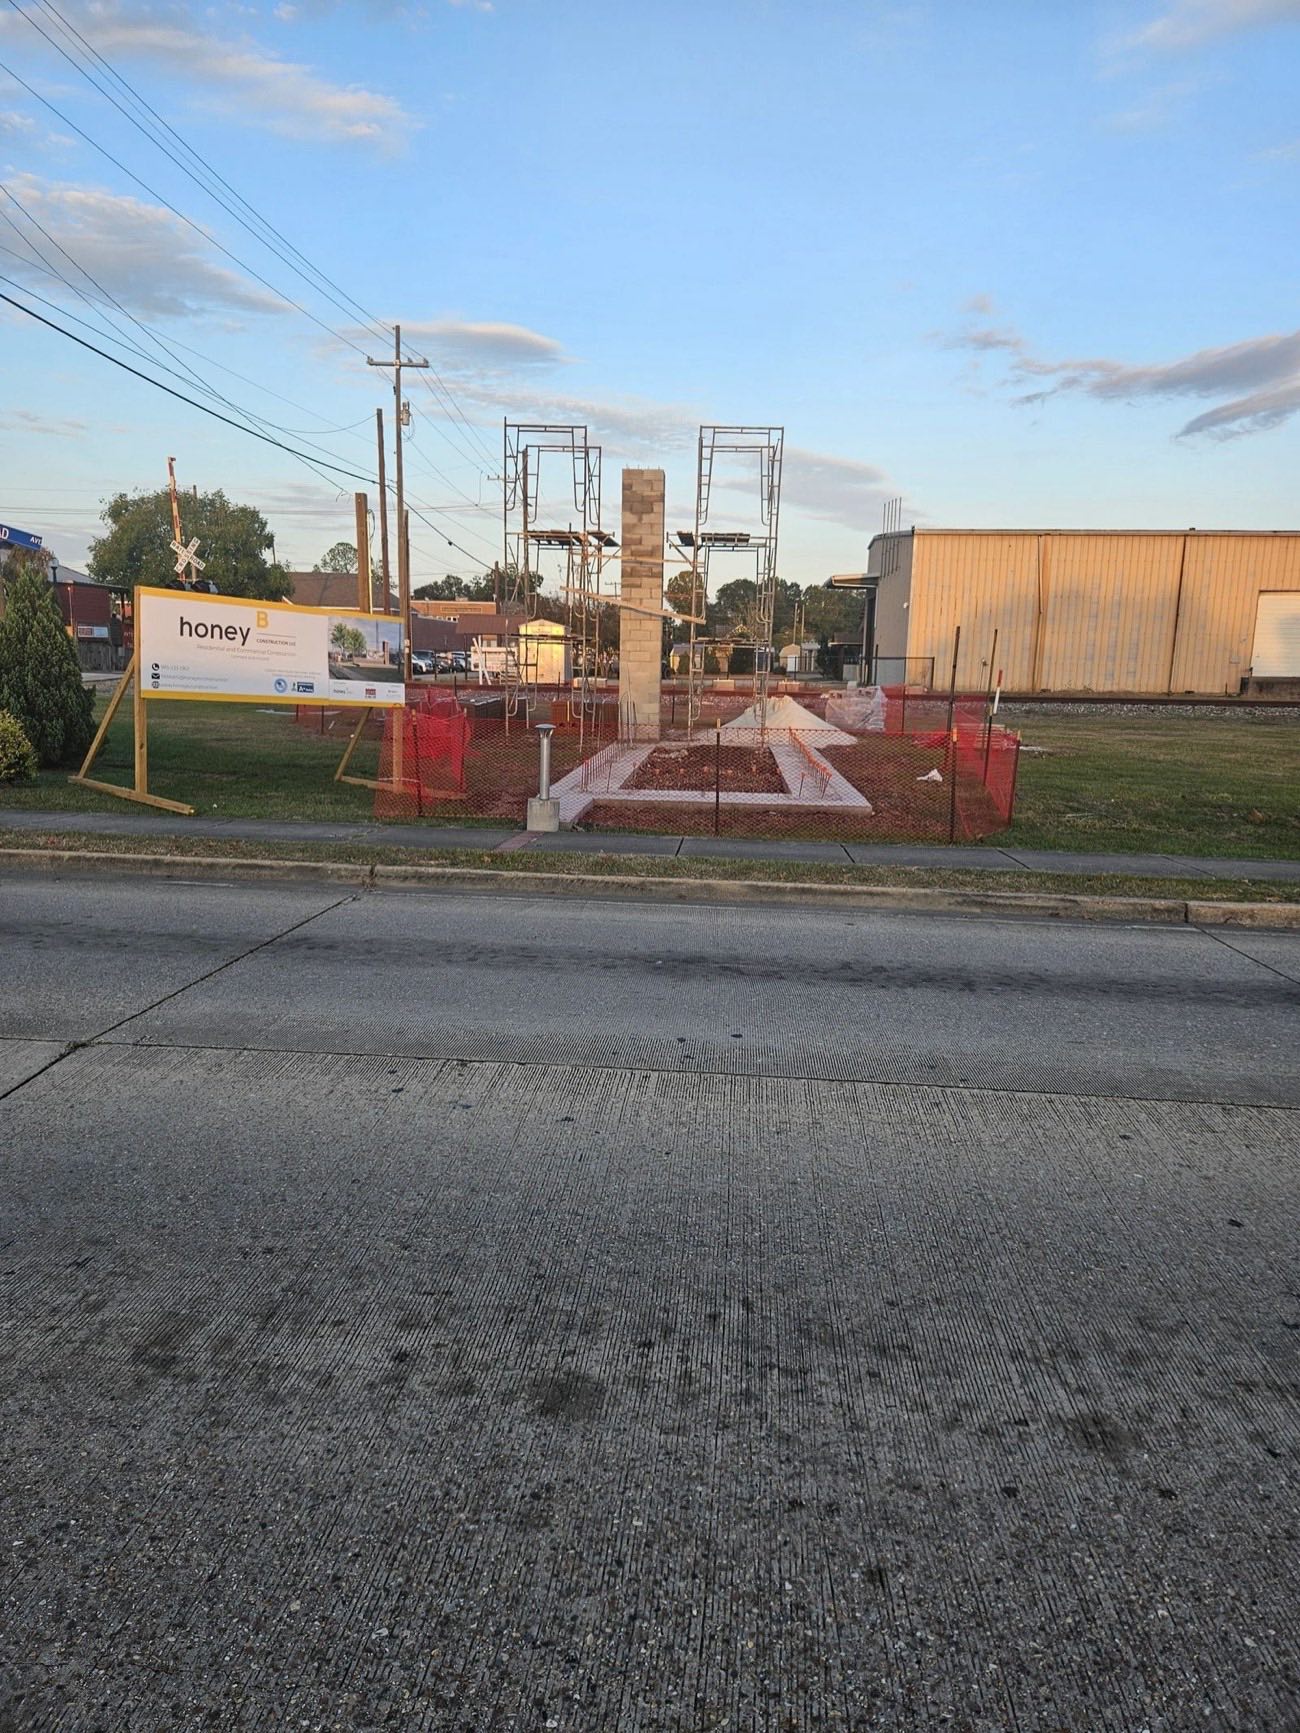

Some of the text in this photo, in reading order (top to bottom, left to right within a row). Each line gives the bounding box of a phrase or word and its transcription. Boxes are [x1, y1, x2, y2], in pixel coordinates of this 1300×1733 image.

[180, 611, 269, 646] honey B
[256, 638, 288, 646] CONSTRUCTION
